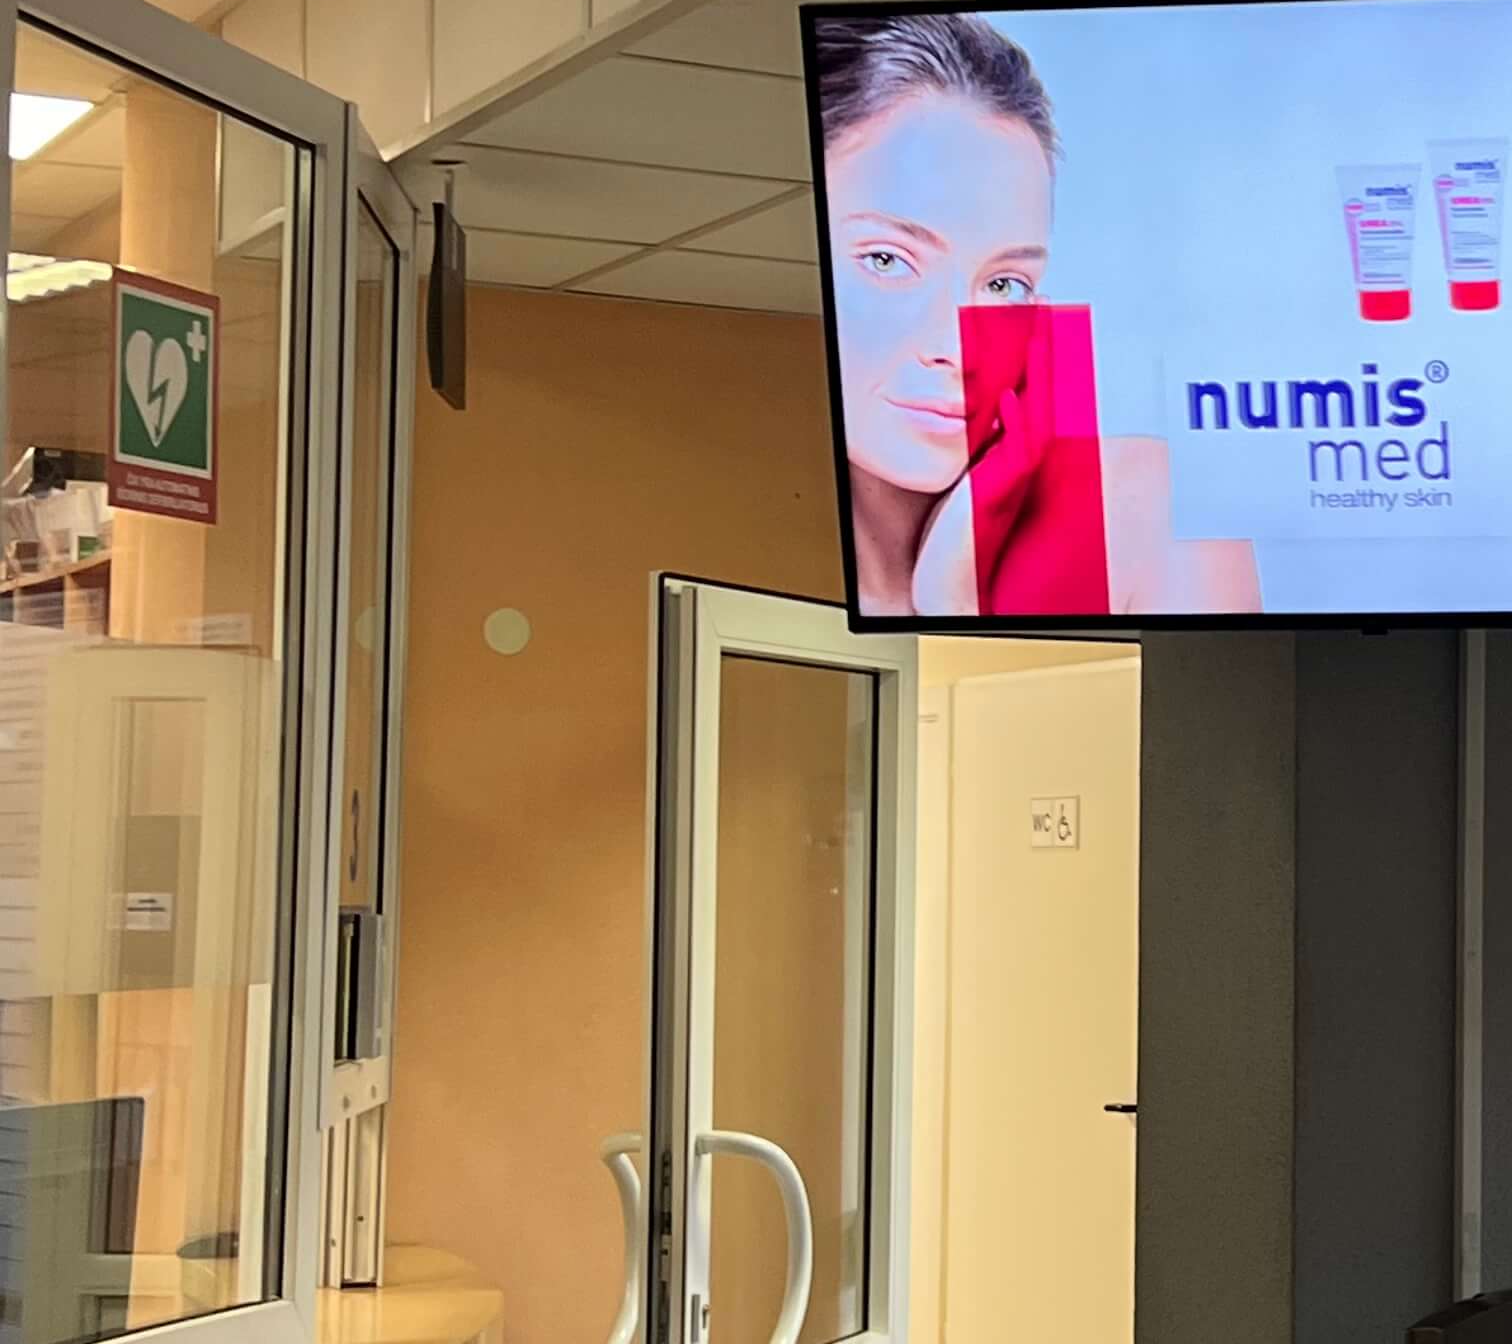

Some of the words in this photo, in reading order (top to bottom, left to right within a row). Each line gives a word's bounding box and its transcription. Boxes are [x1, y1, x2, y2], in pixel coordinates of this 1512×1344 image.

[1308, 420, 1451, 482] med
[1310, 488, 1398, 511] healthy
[1404, 488, 1452, 507] skin
